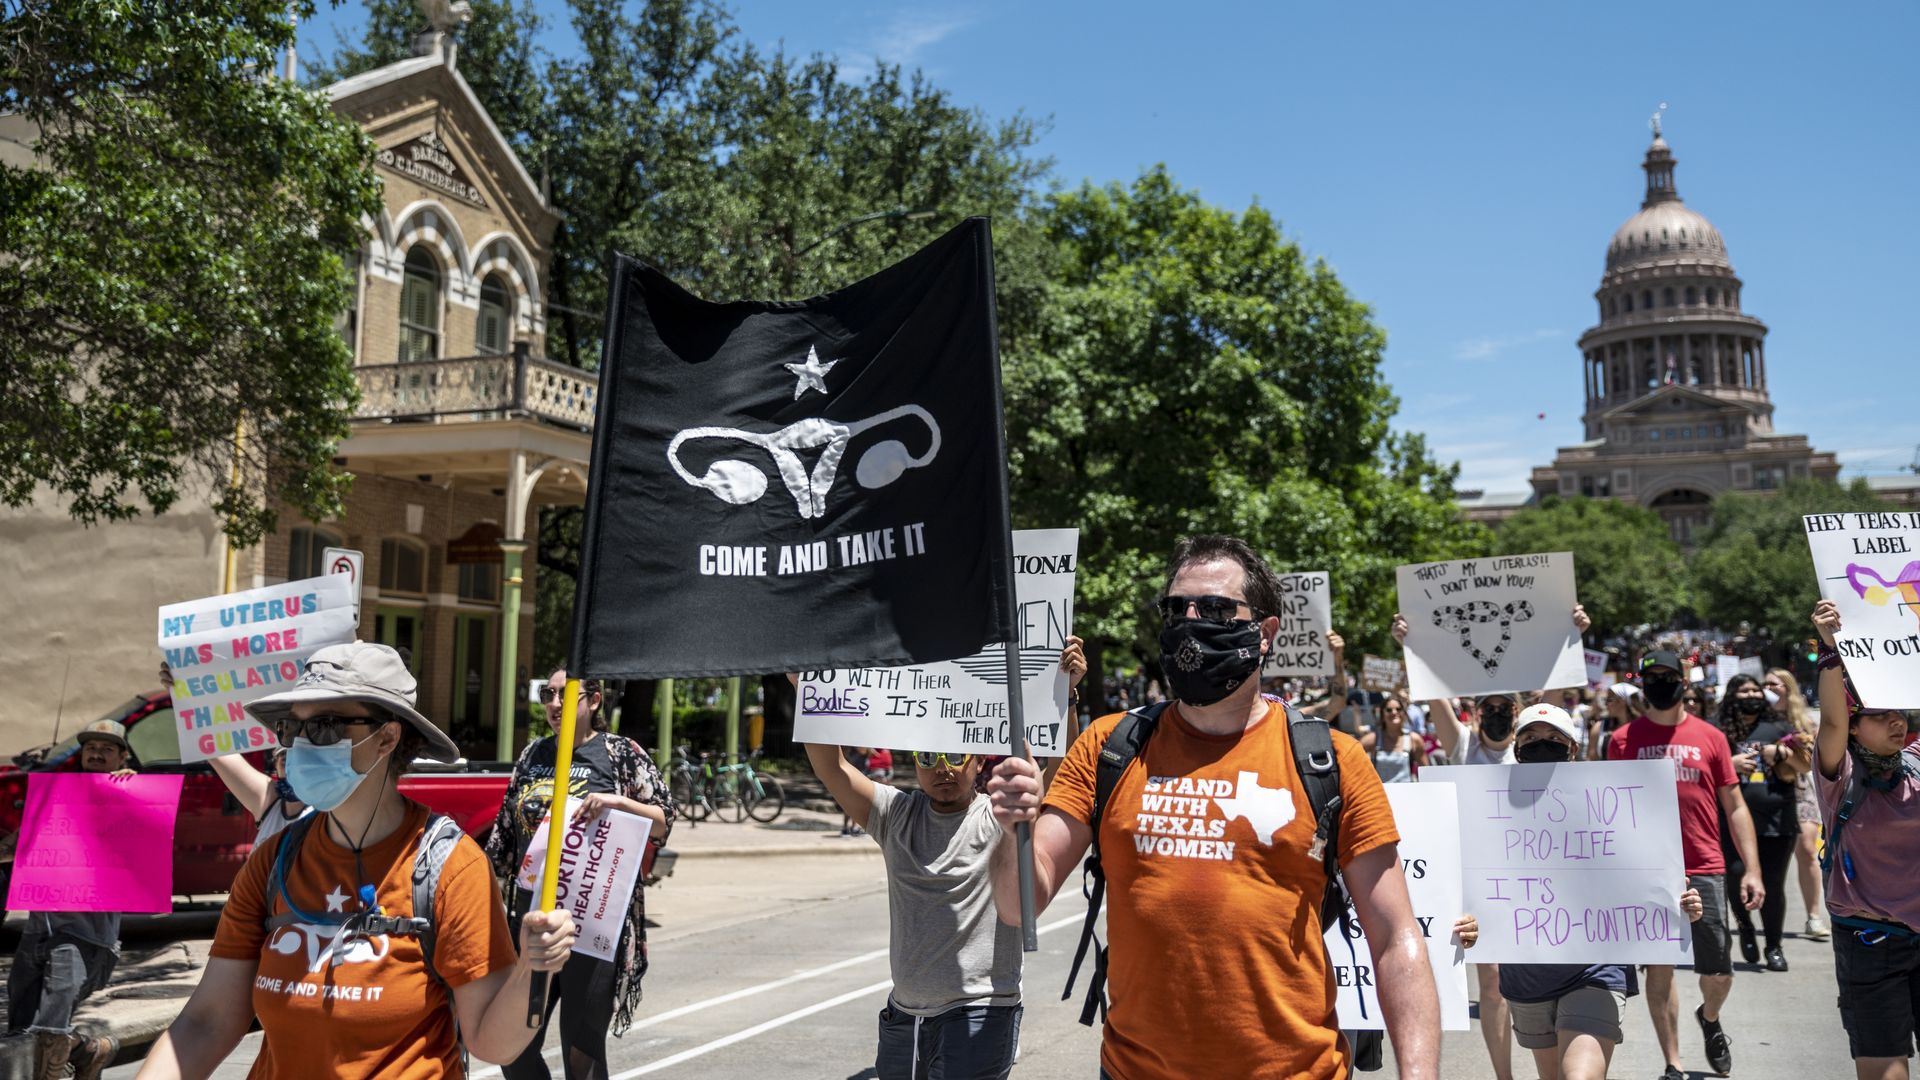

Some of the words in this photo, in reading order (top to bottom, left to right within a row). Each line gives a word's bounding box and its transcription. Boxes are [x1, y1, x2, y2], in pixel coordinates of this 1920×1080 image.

[1805, 513, 1847, 533] HEY
[700, 544, 767, 577] COME
[778, 541, 828, 575] AND
[837, 528, 897, 567] TAKE
[903, 522, 926, 557] IT
[1852, 536, 1912, 555] LABEL
[1462, 561, 1477, 577] MY
[1280, 575, 1324, 592] STOP
[1424, 588, 1432, 600] I
[1473, 575, 1502, 588] KNOW
[163, 613, 196, 638] MY
[219, 592, 317, 628] UTERUS
[1279, 617, 1312, 632] UIT
[165, 643, 213, 670] HAS
[232, 628, 299, 660] MORE
[1277, 630, 1322, 648] OVER
[1838, 637, 1875, 661] STAY
[1883, 633, 1920, 656] OUT
[1265, 650, 1324, 669] FOLKS!
[849, 668, 901, 690] WITH
[179, 701, 246, 731] THAN
[975, 698, 1007, 719] LIFE
[999, 720, 1060, 751] CICE!
[1637, 744, 1702, 761] AUSTIN'S
[1144, 776, 1234, 797] STAND
[1141, 794, 1209, 817] WITH
[1585, 785, 1644, 829] NOT
[1136, 813, 1227, 839] TEXAS
[1133, 833, 1236, 861] WOMEN
[1505, 829, 1616, 861] PRO-LIFE
[572, 819, 612, 921] HEALTHCARE
[594, 847, 625, 920] RosiesLaw.org
[1514, 905, 1685, 946] PRO-CONTROL
[256, 975, 283, 992] COME
[285, 981, 317, 997] AND
[322, 985, 362, 1001] TAKE
[366, 986, 384, 1001] IT
